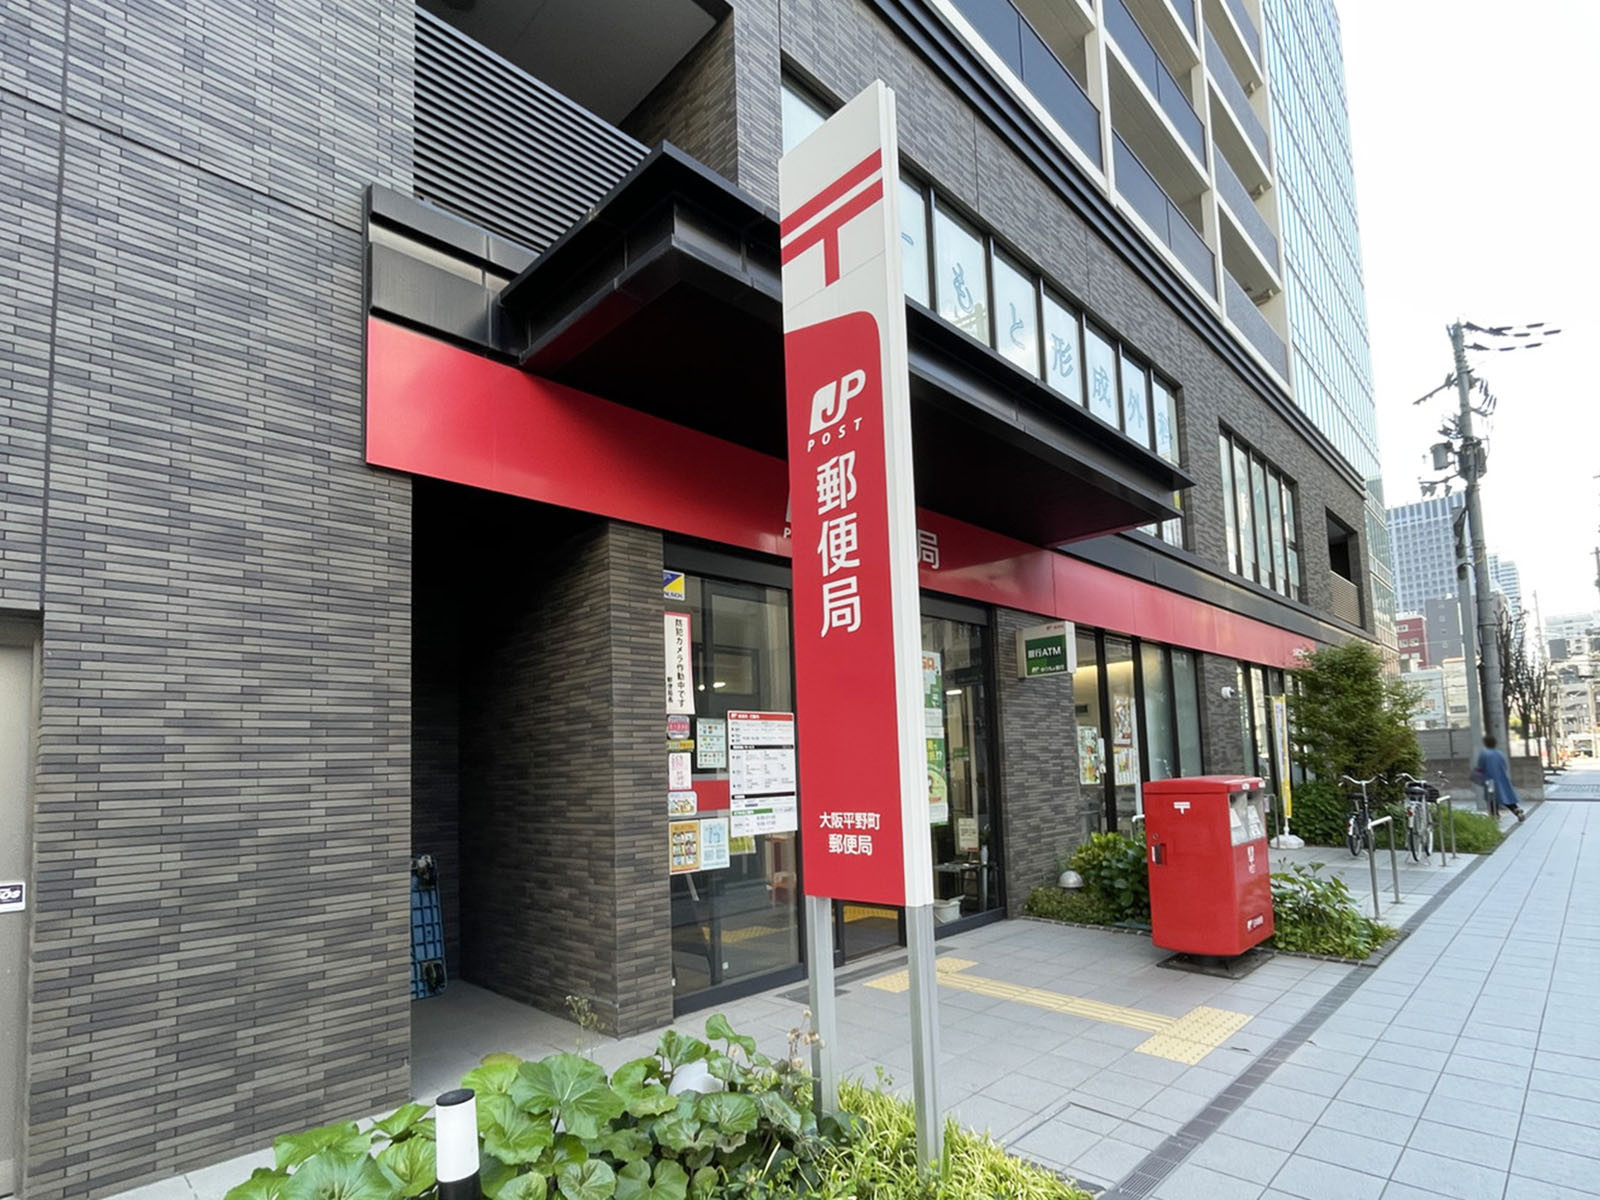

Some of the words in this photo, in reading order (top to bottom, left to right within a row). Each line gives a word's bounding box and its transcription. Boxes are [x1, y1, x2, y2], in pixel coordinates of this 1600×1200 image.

[807, 416, 863, 452] POST
[816, 450, 862, 638] 郵便局
[819, 811, 881, 831] 大阪平野町
[828, 833, 873, 856] 郵便局
